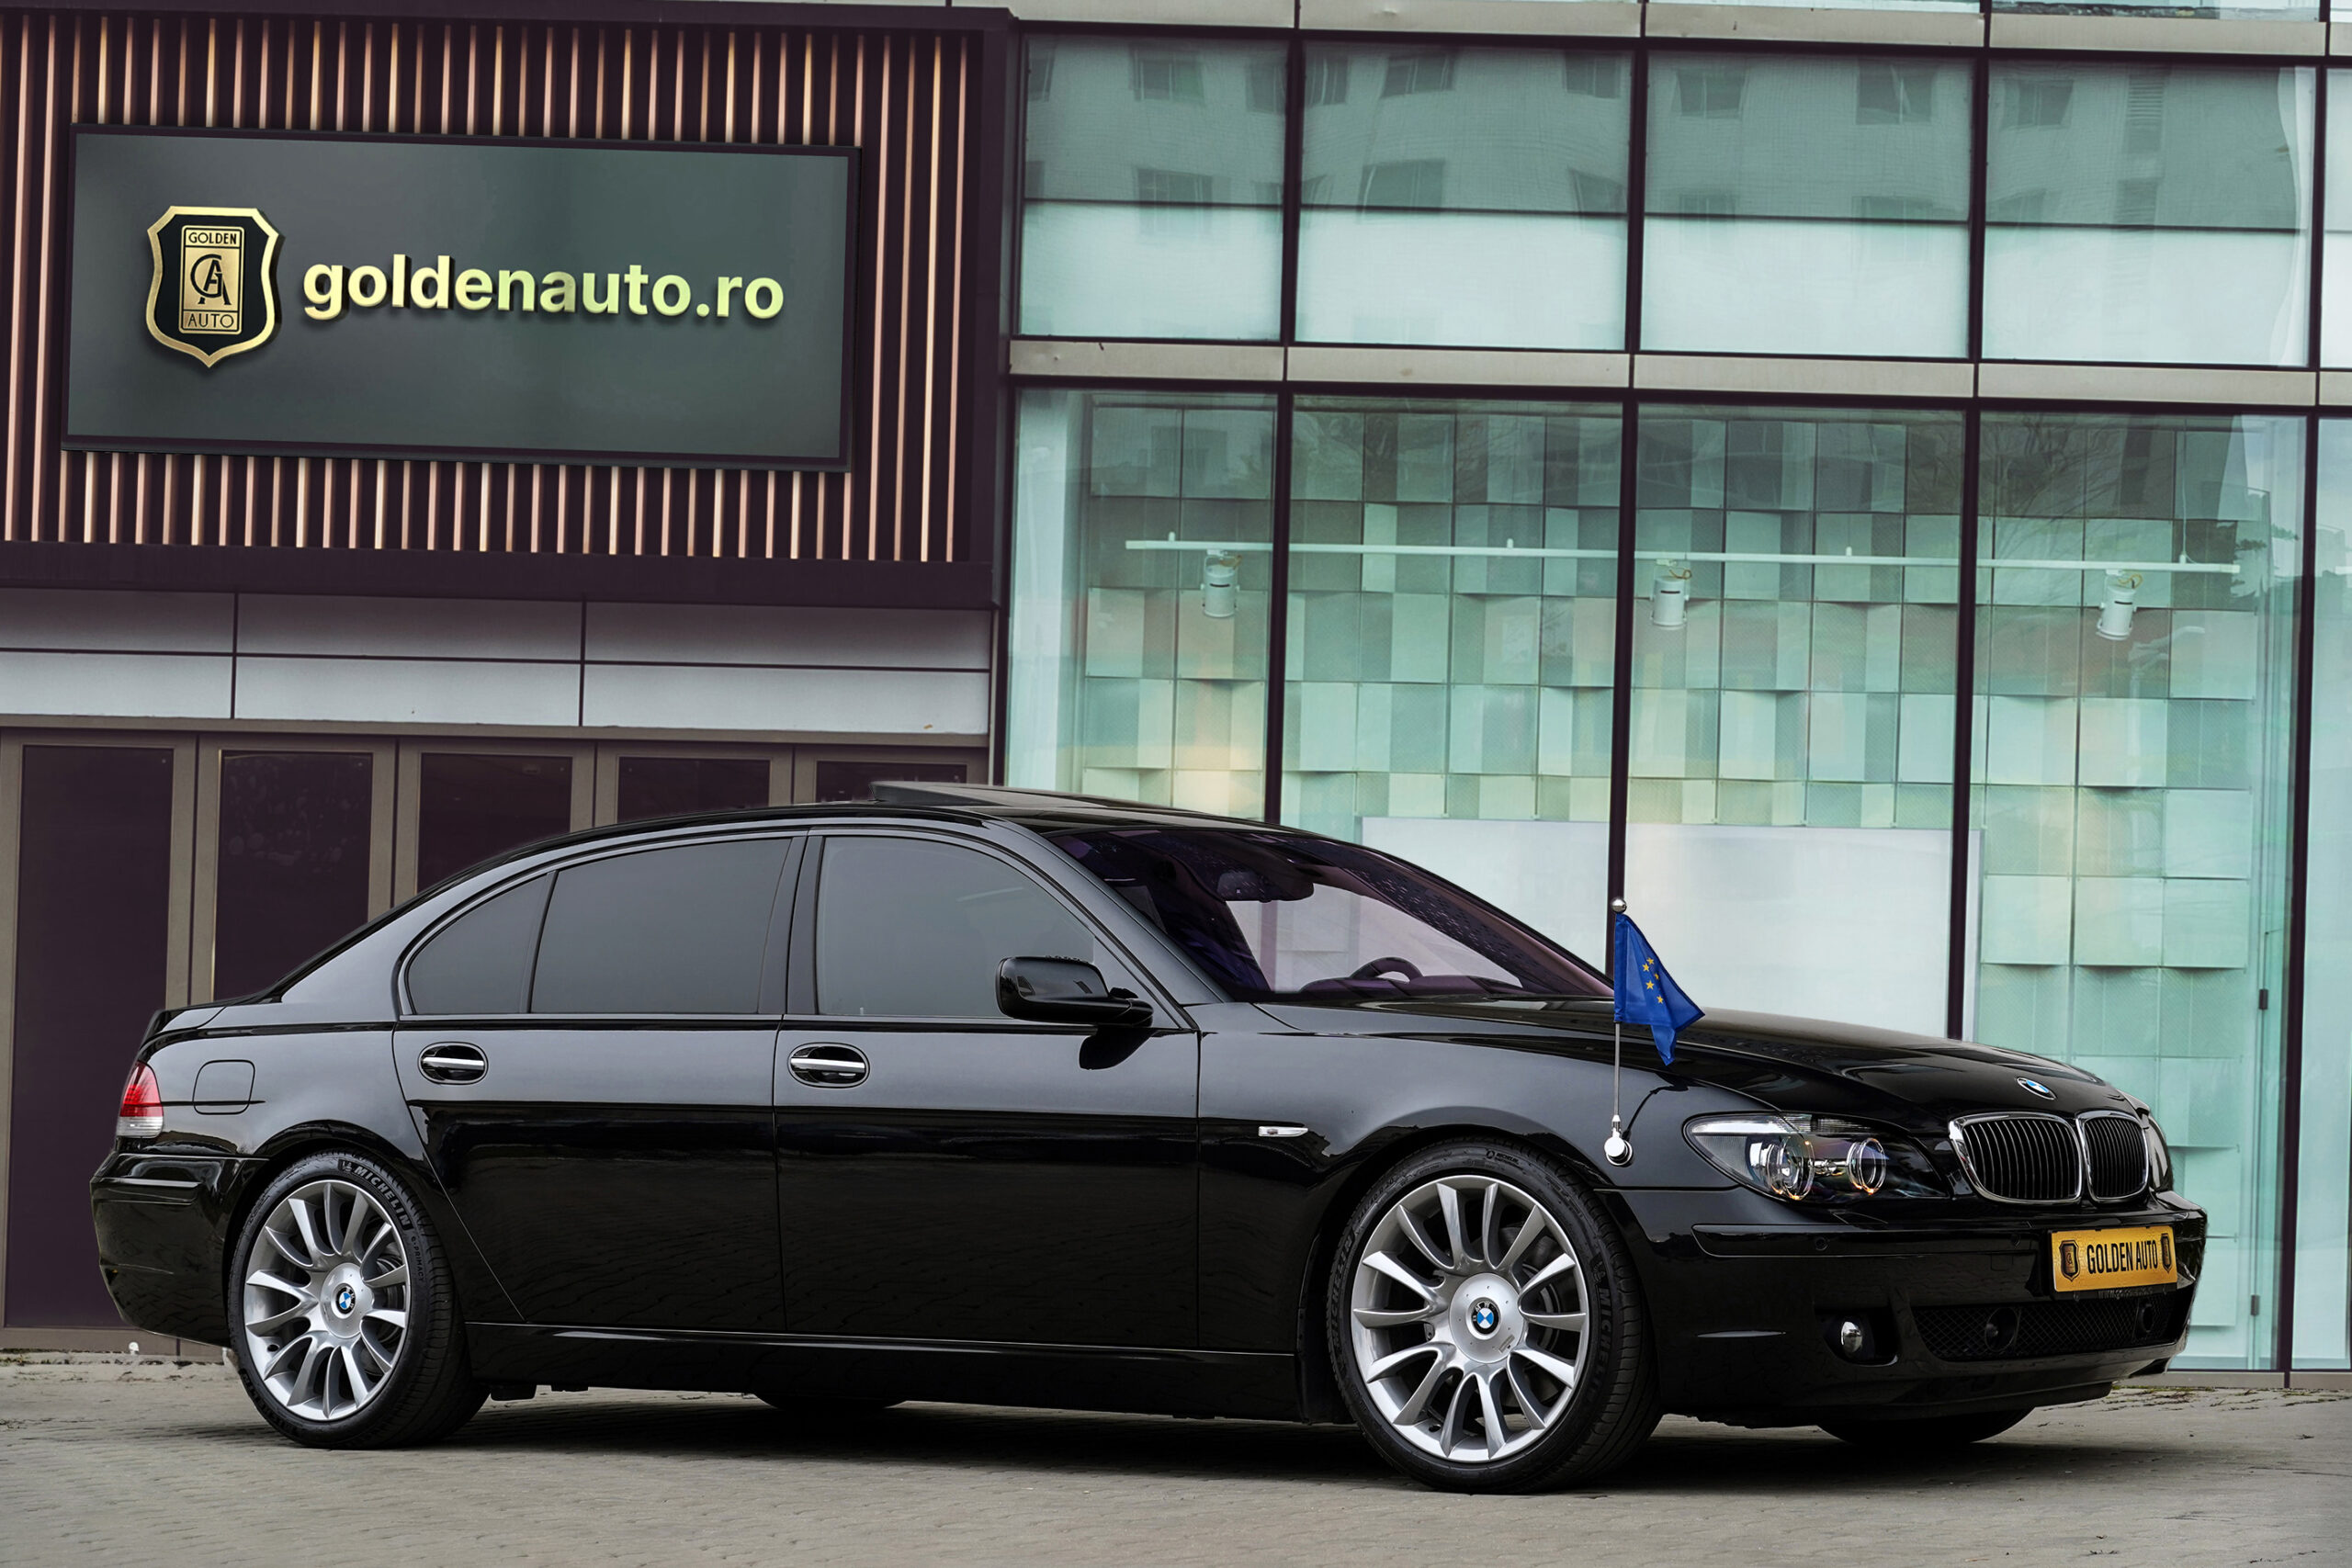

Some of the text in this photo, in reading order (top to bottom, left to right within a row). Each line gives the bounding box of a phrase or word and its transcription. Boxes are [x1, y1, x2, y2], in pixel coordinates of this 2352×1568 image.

[188, 231, 237, 245] GOLDEN
[303, 254, 784, 321] goldenauto.ro
[187, 313, 234, 328] AUTO
[354, 1166, 411, 1228] MICHELIN
[2086, 1240, 2133, 1274] GOLDEN
[2135, 1240, 2158, 1270] AUTO
